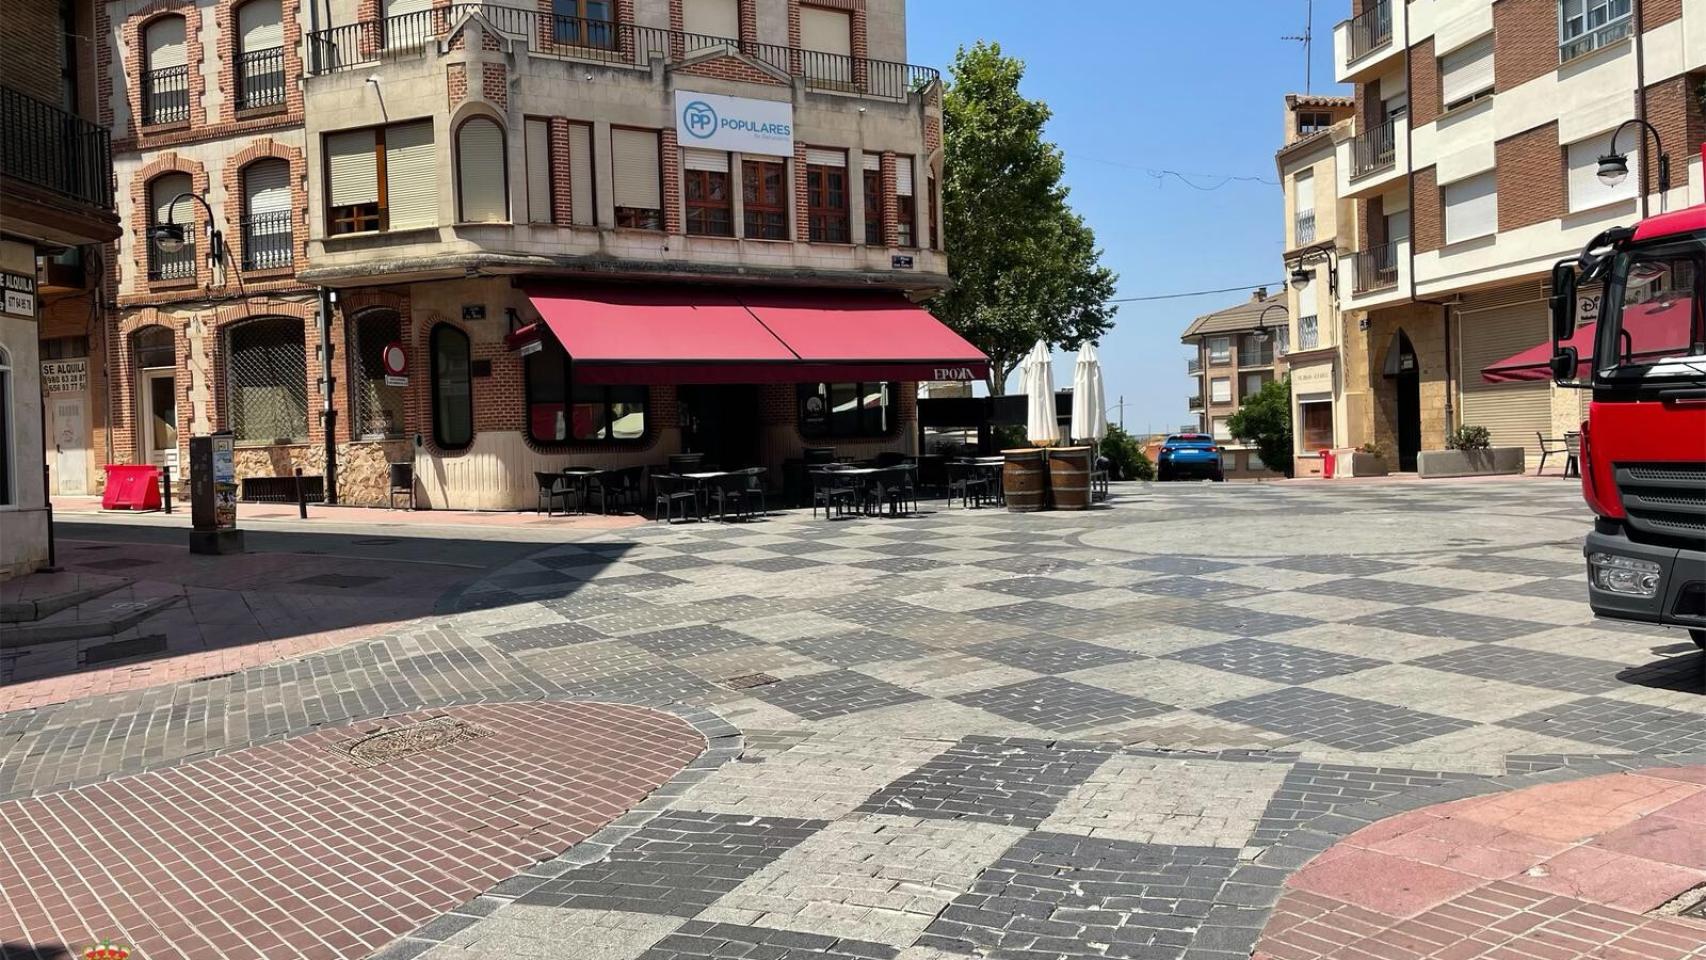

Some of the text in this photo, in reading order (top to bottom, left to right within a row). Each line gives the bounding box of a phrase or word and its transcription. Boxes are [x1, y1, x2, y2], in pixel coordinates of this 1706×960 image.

[690, 113, 711, 130] PP
[721, 118, 791, 136] POPULARES
[6, 274, 34, 293] ALQUILA
[43, 362, 85, 375] SE ALQUILA
[934, 367, 976, 380] EPOKA
